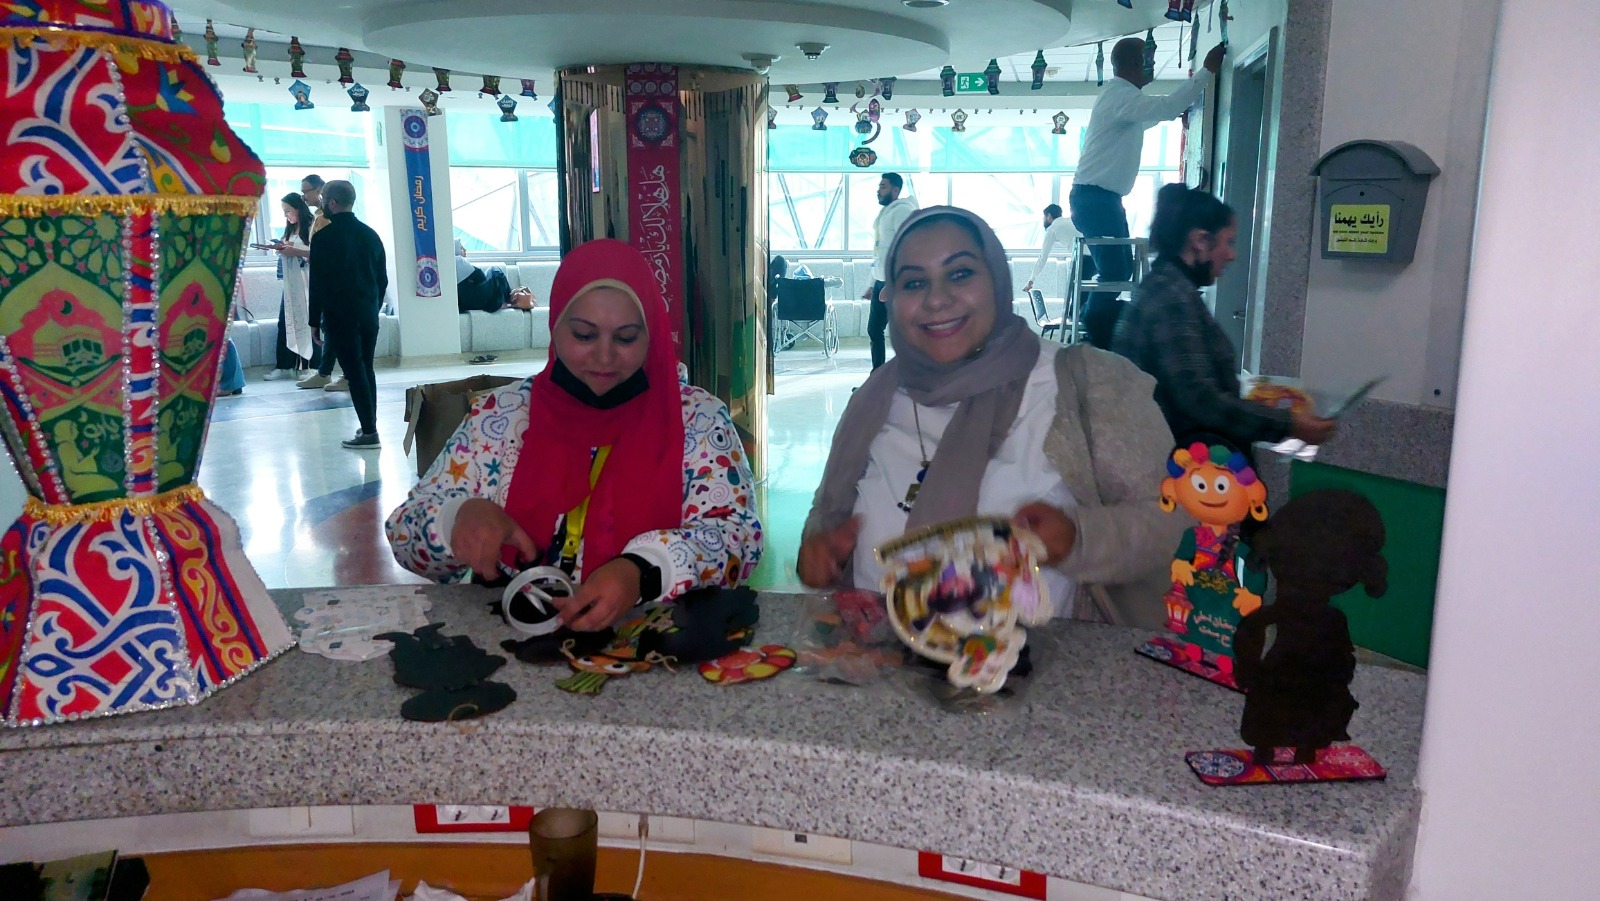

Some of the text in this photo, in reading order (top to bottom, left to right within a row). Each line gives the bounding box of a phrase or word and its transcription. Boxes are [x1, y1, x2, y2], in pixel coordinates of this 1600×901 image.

[413, 175, 428, 232] رمضان كريم
[1334, 211, 1384, 228] رأيك يهمنا
